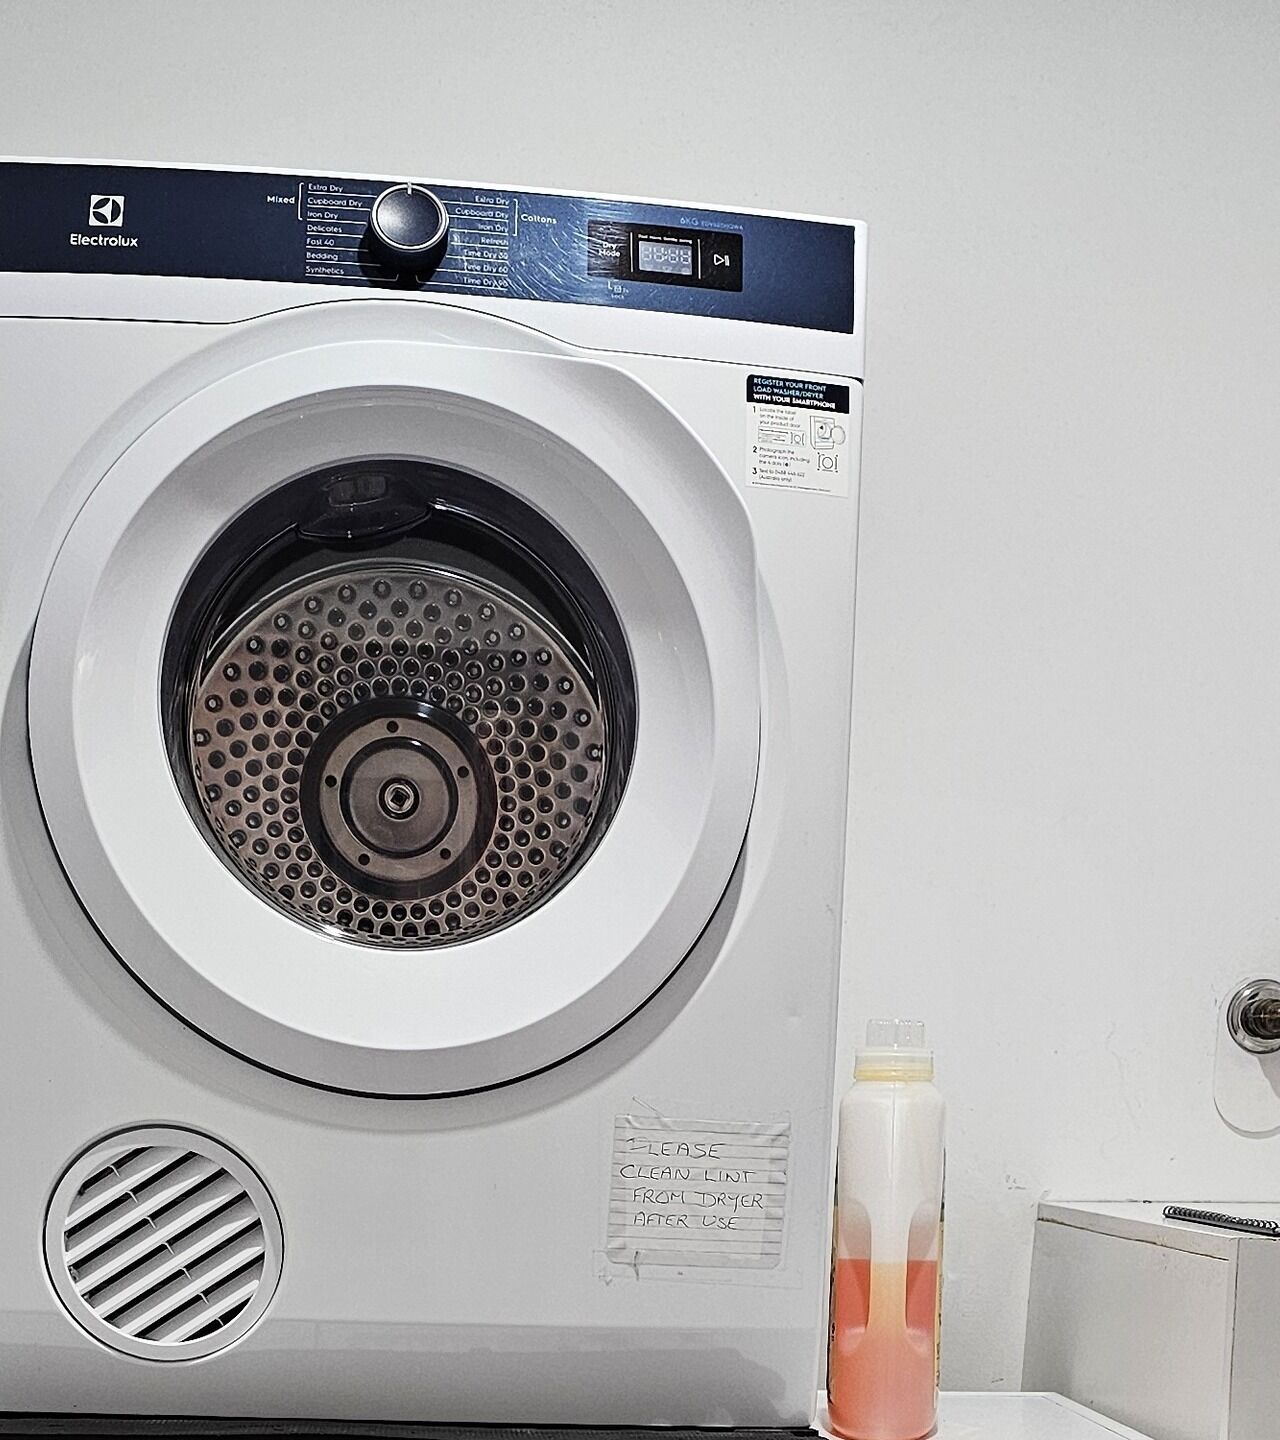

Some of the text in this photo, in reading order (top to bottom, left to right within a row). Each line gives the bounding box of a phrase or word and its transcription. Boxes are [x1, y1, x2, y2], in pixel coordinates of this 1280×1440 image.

[308, 183, 327, 191] Extra
[267, 195, 295, 204] Mixed
[308, 197, 363, 207] Cupboard Dry
[456, 207, 508, 219] Cupboard Dry
[521, 214, 557, 224] Cottons
[307, 224, 342, 233] Delicates
[70, 234, 138, 247] Electrolux
[306, 252, 338, 261] Bedding
[306, 266, 344, 275] Synthetics
[754, 378, 783, 386] REGISTER
[805, 383, 826, 392] FRONT
[774, 388, 824, 399] WASHER/DRYER
[792, 397, 836, 409] SMARTPHONE
[620, 1164, 757, 1183] CLEAN LINT
[633, 1187, 763, 1213] FROM DRYER
[633, 1211, 740, 1230] AFTER USE
